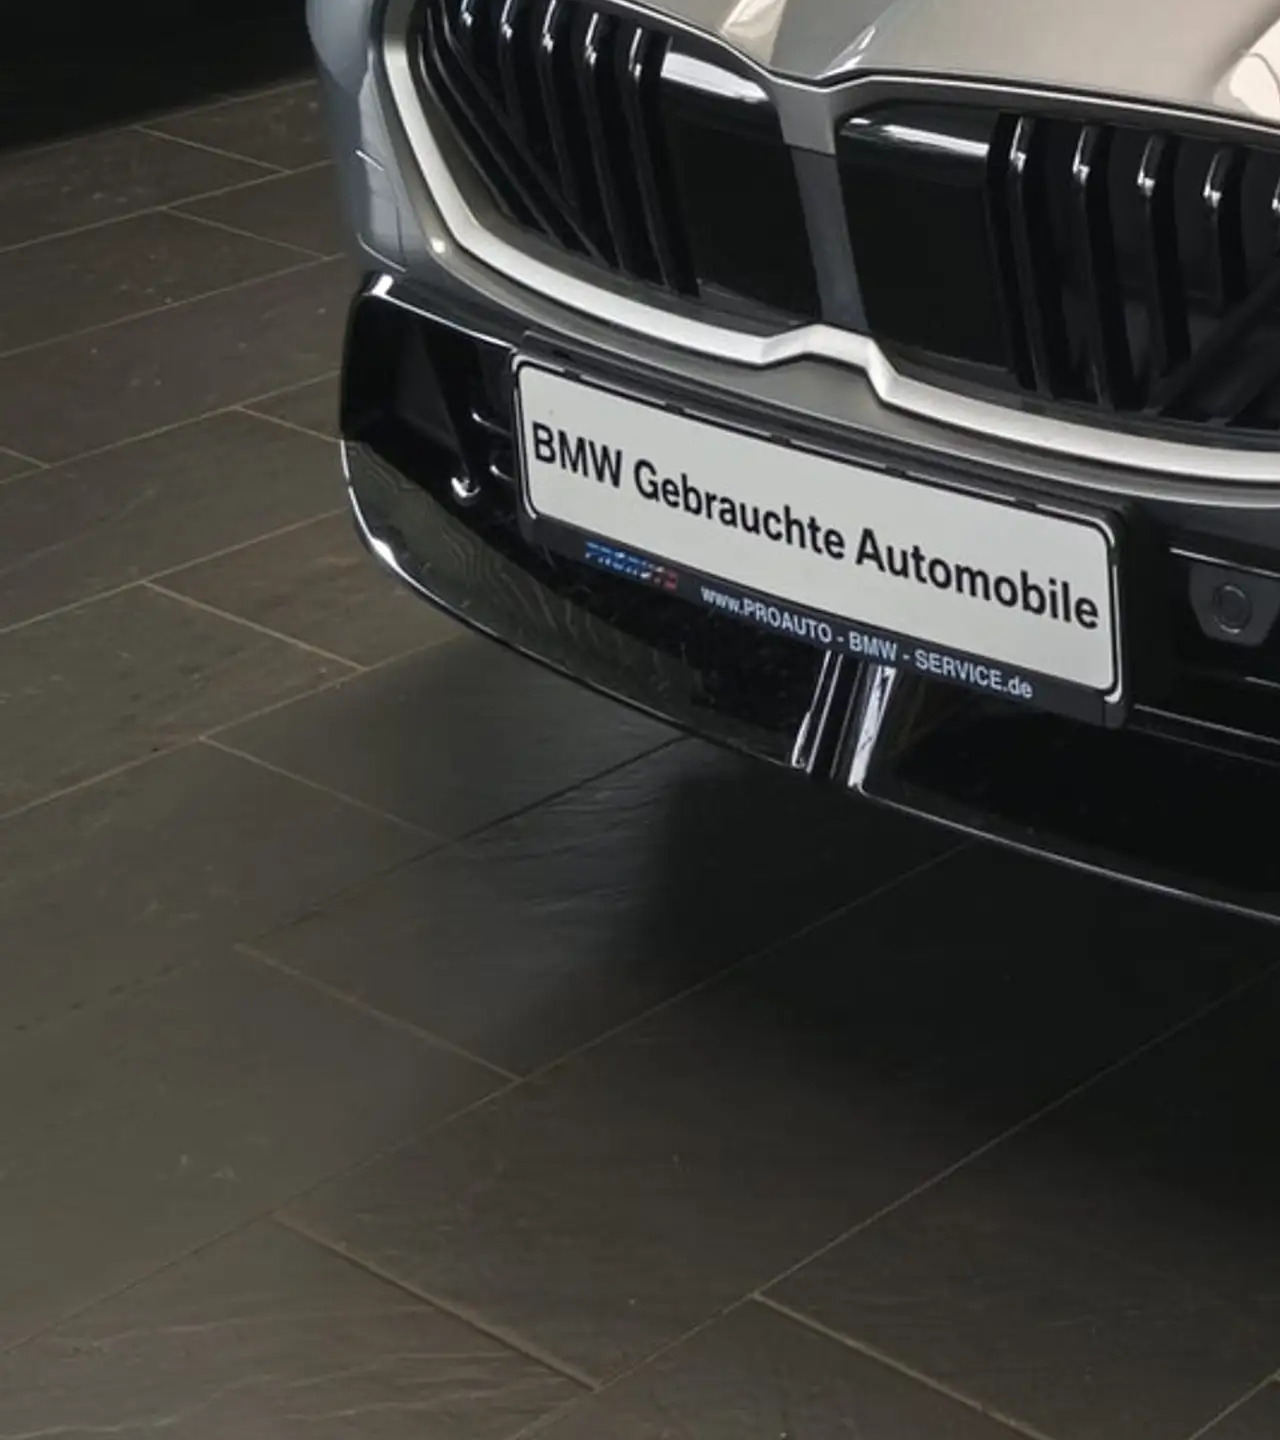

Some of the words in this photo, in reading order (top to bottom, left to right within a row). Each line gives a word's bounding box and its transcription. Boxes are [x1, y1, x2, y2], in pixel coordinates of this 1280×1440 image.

[532, 421, 622, 489] BMW
[633, 458, 846, 560] Gebrauchte
[855, 527, 1099, 630] Automobile
[701, 586, 832, 643] www.PROAUTO
[849, 631, 898, 660] BMW
[915, 649, 1033, 698] SERVICE.de
